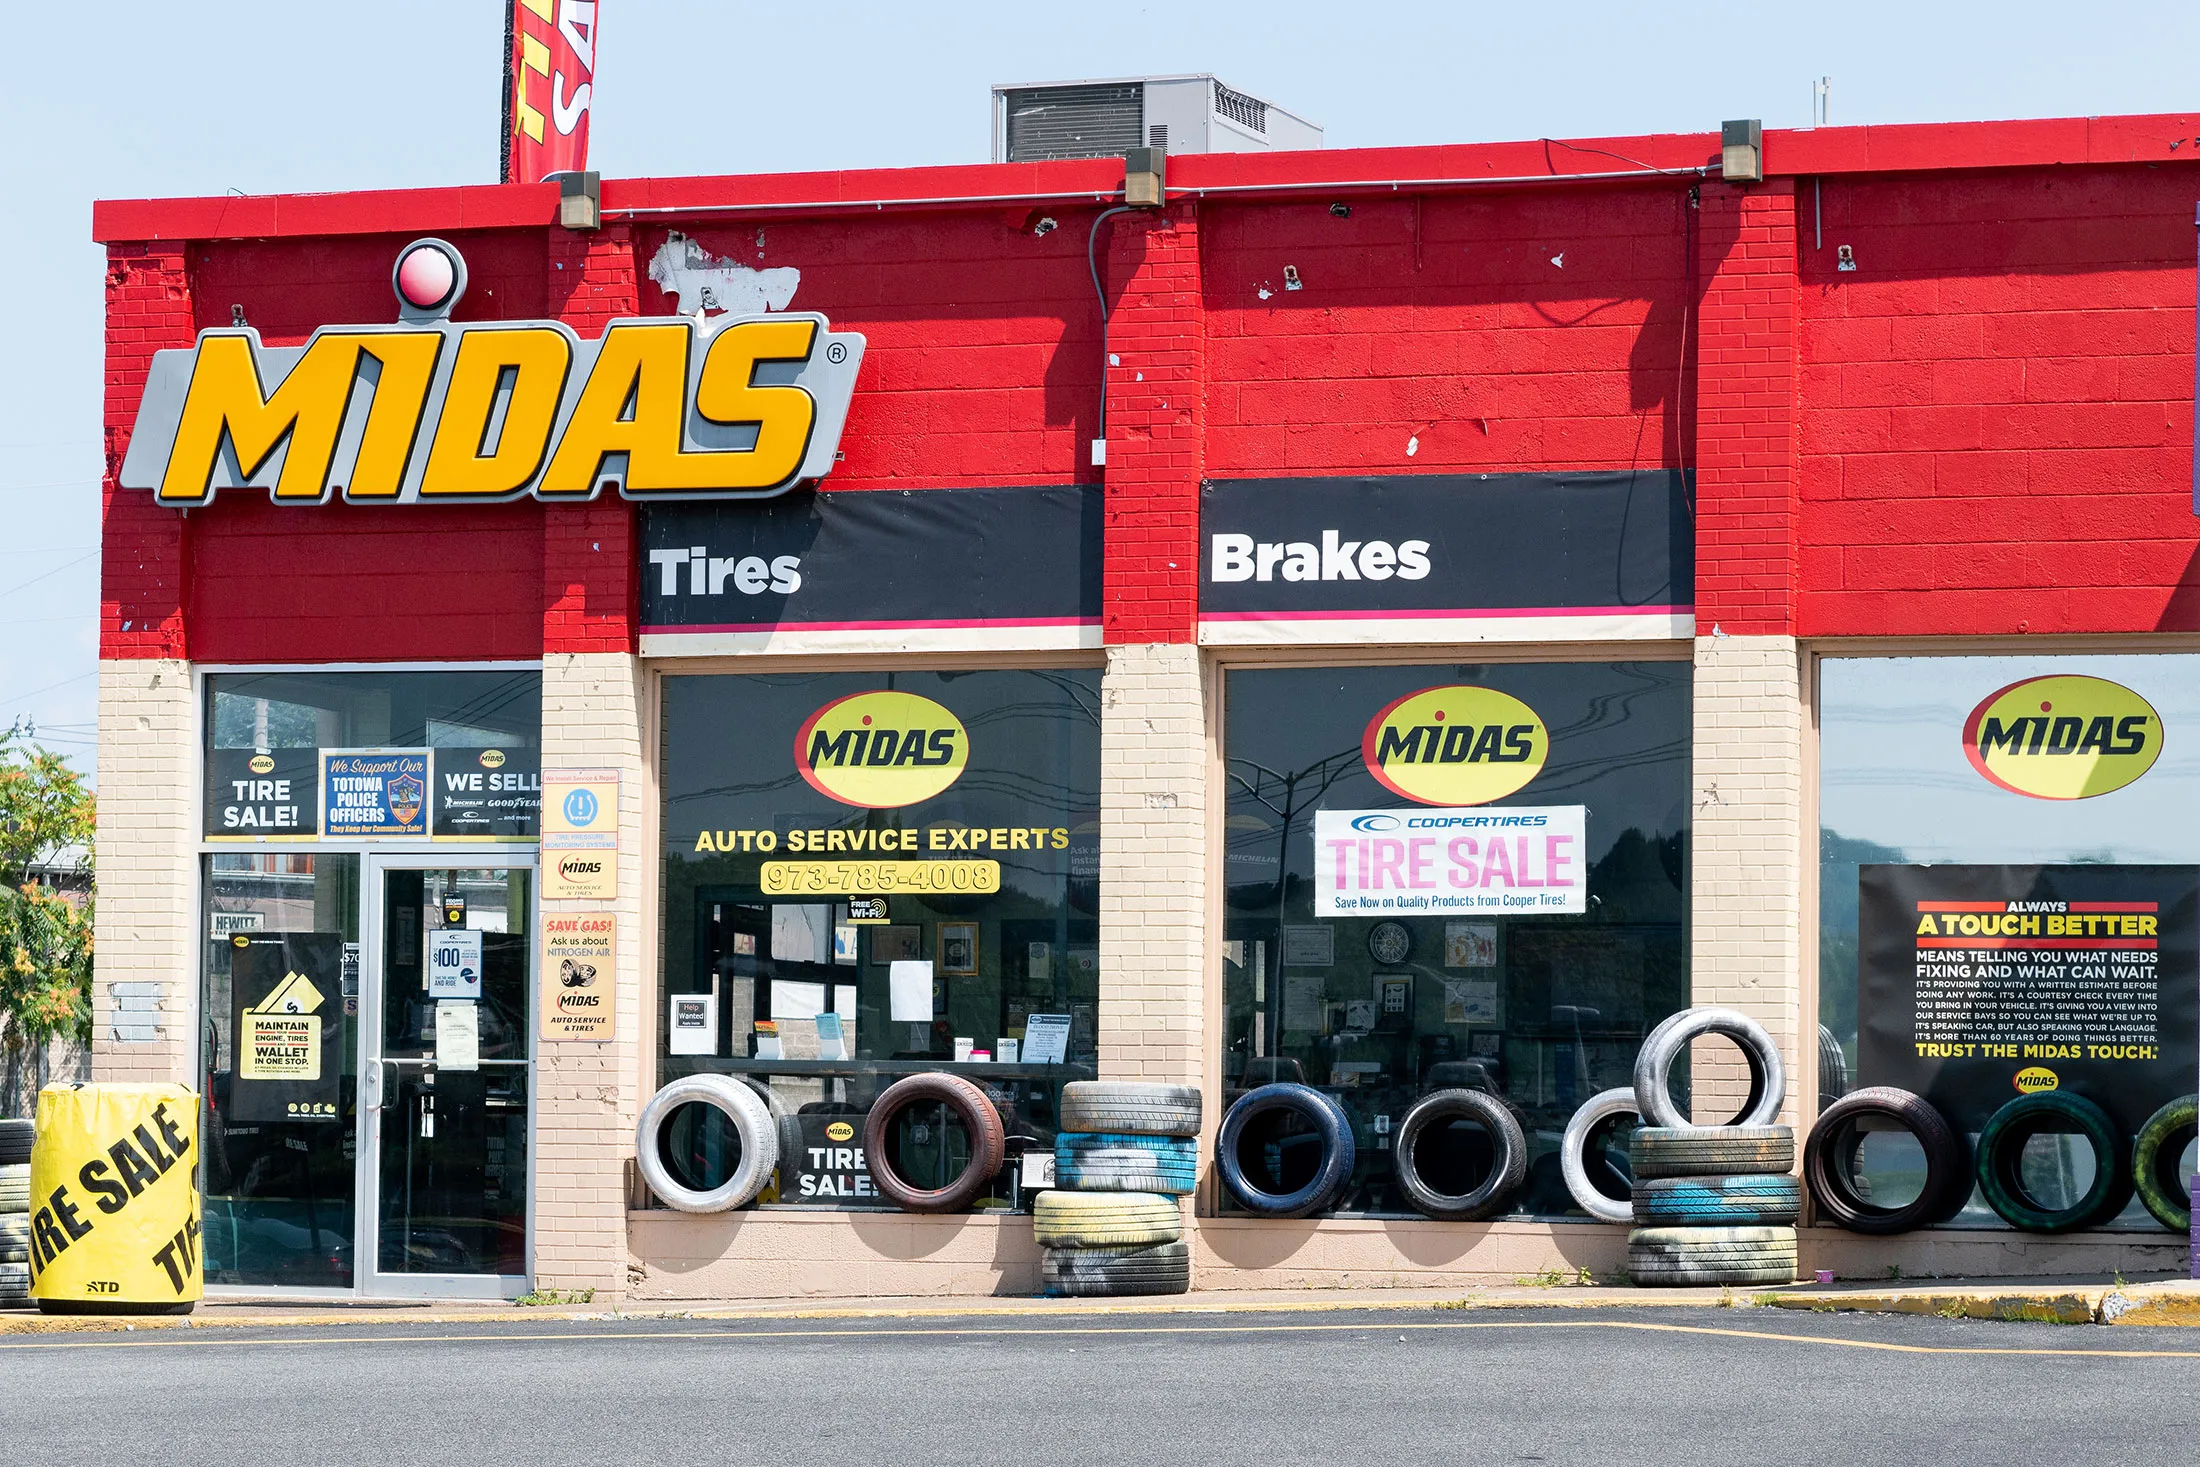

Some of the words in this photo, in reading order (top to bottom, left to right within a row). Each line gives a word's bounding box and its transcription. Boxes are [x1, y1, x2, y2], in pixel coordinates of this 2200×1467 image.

[159, 240, 818, 499] MIDAS
[1211, 530, 1431, 582] Brakes
[650, 546, 801, 596] Tires
[1979, 701, 2147, 763] MIDAS
[808, 715, 956, 772] MIDAS
[1377, 710, 1534, 770] MIDAS
[251, 758, 273, 768] MIDAS
[481, 753, 504, 762] MIDAS
[330, 759, 349, 773] We
[350, 758, 398, 776] Support
[399, 757, 424, 773] Our
[332, 777, 383, 792] TOTOWA
[445, 773, 483, 791] WE
[488, 773, 541, 791] SELL
[232, 780, 291, 801] TIRE
[337, 792, 378, 807] POLICE
[223, 806, 298, 827] SALE!
[329, 808, 386, 823] OFFICERS
[1407, 816, 1548, 828] COOPERTIRES
[694, 830, 777, 852] AUTO
[787, 828, 918, 852] SERVICE
[929, 827, 1069, 850] EXPERTS
[562, 857, 602, 874] MIDAS
[1328, 838, 1436, 889] TIRE
[1448, 836, 1574, 888] SALE
[767, 863, 994, 890] 973-785-4008
[1336, 897, 1357, 908] Save
[1361, 897, 1379, 908] Now
[1383, 899, 1393, 907] on
[1397, 896, 1428, 909] Quality
[1432, 896, 1474, 906] Products
[1478, 895, 1499, 906] from
[1504, 895, 1536, 908] Cooper
[1540, 894, 1565, 905] Tires!
[2007, 902, 2067, 913] ALWAYS
[851, 907, 879, 918] Wi-Fi
[216, 916, 256, 930] HEWITT
[547, 920, 578, 932] SAVE
[581, 920, 612, 932] GAS!
[1916, 913, 1939, 935] A
[1940, 914, 2040, 936] TOUCH
[2047, 915, 2158, 936] BETTER
[551, 937, 567, 945] Ask
[582, 937, 608, 945] about
[433, 948, 460, 967] $100
[547, 948, 593, 957] NITROGEN
[596, 948, 610, 957] AIR
[1917, 951, 1965, 962] MEANS
[1969, 951, 2027, 962] TELLING
[2032, 952, 2060, 962] YOU
[2065, 952, 2107, 962] WHAT
[2112, 952, 2157, 962] NEEDS
[1917, 965, 1970, 978] FIXING
[1975, 965, 2011, 977] AND
[2017, 966, 2066, 978] WHAT
[2072, 966, 2105, 978] CAN
[2111, 966, 2157, 978] WAIT.
[1916, 980, 1931, 988] IT'S
[1933, 980, 1981, 989] PROVIDING
[1982, 980, 2001, 989] YOU
[2003, 981, 2026, 989] WITH
[2037, 981, 2076, 989] WRITTEN
[2078, 981, 2120, 989] ESTIMATE
[2122, 982, 2158, 990] BEFORE
[560, 991, 600, 1007] MIDAS
[1915, 990, 1944, 999] DOING
[1945, 991, 1965, 999] ANY
[1966, 991, 1997, 999] WORK.
[1999, 991, 2015, 999] IT'S
[2026, 991, 2072, 1000] COURTESY
[2074, 992, 2103, 1000] CHECK
[2105, 992, 2135, 1000] EVERY
[2136, 992, 2158, 1000] TIME
[1915, 1001, 1934, 1009] YOU
[1934, 1001, 1961, 1010] BRING
[1962, 1001, 1972, 1009] IN
[1974, 1001, 1998, 1009] YOUR
[1999, 1002, 2037, 1010] VEHICLE.
[2039, 1002, 2055, 1010] IT'S
[2056, 1002, 2085, 1010] GIVING
[2086, 1002, 2105, 1010] YOU
[2113, 1003, 2136, 1011] VIEW
[2137, 1003, 2158, 1011] INTO
[1915, 1011, 1934, 1020] OUR
[1935, 1011, 1972, 1020] SERVICE
[1974, 1012, 1997, 1020] BAYS
[1998, 1012, 2011, 1020] SO
[2013, 1012, 2031, 1020] YOU
[2033, 1012, 2052, 1020] CAN
[2054, 1013, 2070, 1021] SEE
[2072, 1013, 2098, 1021] WHAT
[2100, 1013, 2128, 1021] WE'RE
[2130, 1013, 2143, 1021] UP
[2144, 1013, 2158, 1022] TO.
[255, 1021, 309, 1030] MAINTAIN
[1915, 1022, 1930, 1030] IT'S
[1931, 1022, 1974, 1030] SPEAKING
[1975, 1022, 1996, 1031] CAR,
[1997, 1023, 2015, 1031] BUT
[2016, 1023, 2039, 1031] ALSO
[2041, 1023, 2083, 1031] SPEAKING
[2084, 1023, 2107, 1032] YOUR
[2109, 1024, 2158, 1032] LANGUAGE.
[1915, 1032, 1931, 1041] IT'S
[1933, 1032, 1959, 1041] MORE
[1962, 1033, 1987, 1041] THAN
[1990, 1033, 2002, 1041] 60
[2004, 1033, 2035, 1041] YEARS
[2052, 1034, 2081, 1042] DOING
[2083, 1034, 2117, 1042] THINGS
[2120, 1034, 2158, 1043] BETTER.
[255, 1047, 309, 1057] WALLET
[1916, 1043, 1975, 1057] TRUST
[1982, 1044, 2017, 1057] THE
[2025, 1045, 2081, 1058] MIDAS
[2088, 1046, 2158, 1059] TOUCH.
[2016, 1072, 2056, 1088] MIDAS
[828, 1126, 852, 1137] MIDAS
[79, 1102, 190, 1214] SALE
[808, 1148, 867, 1170] TIRE
[29, 1184, 94, 1292] IRE
